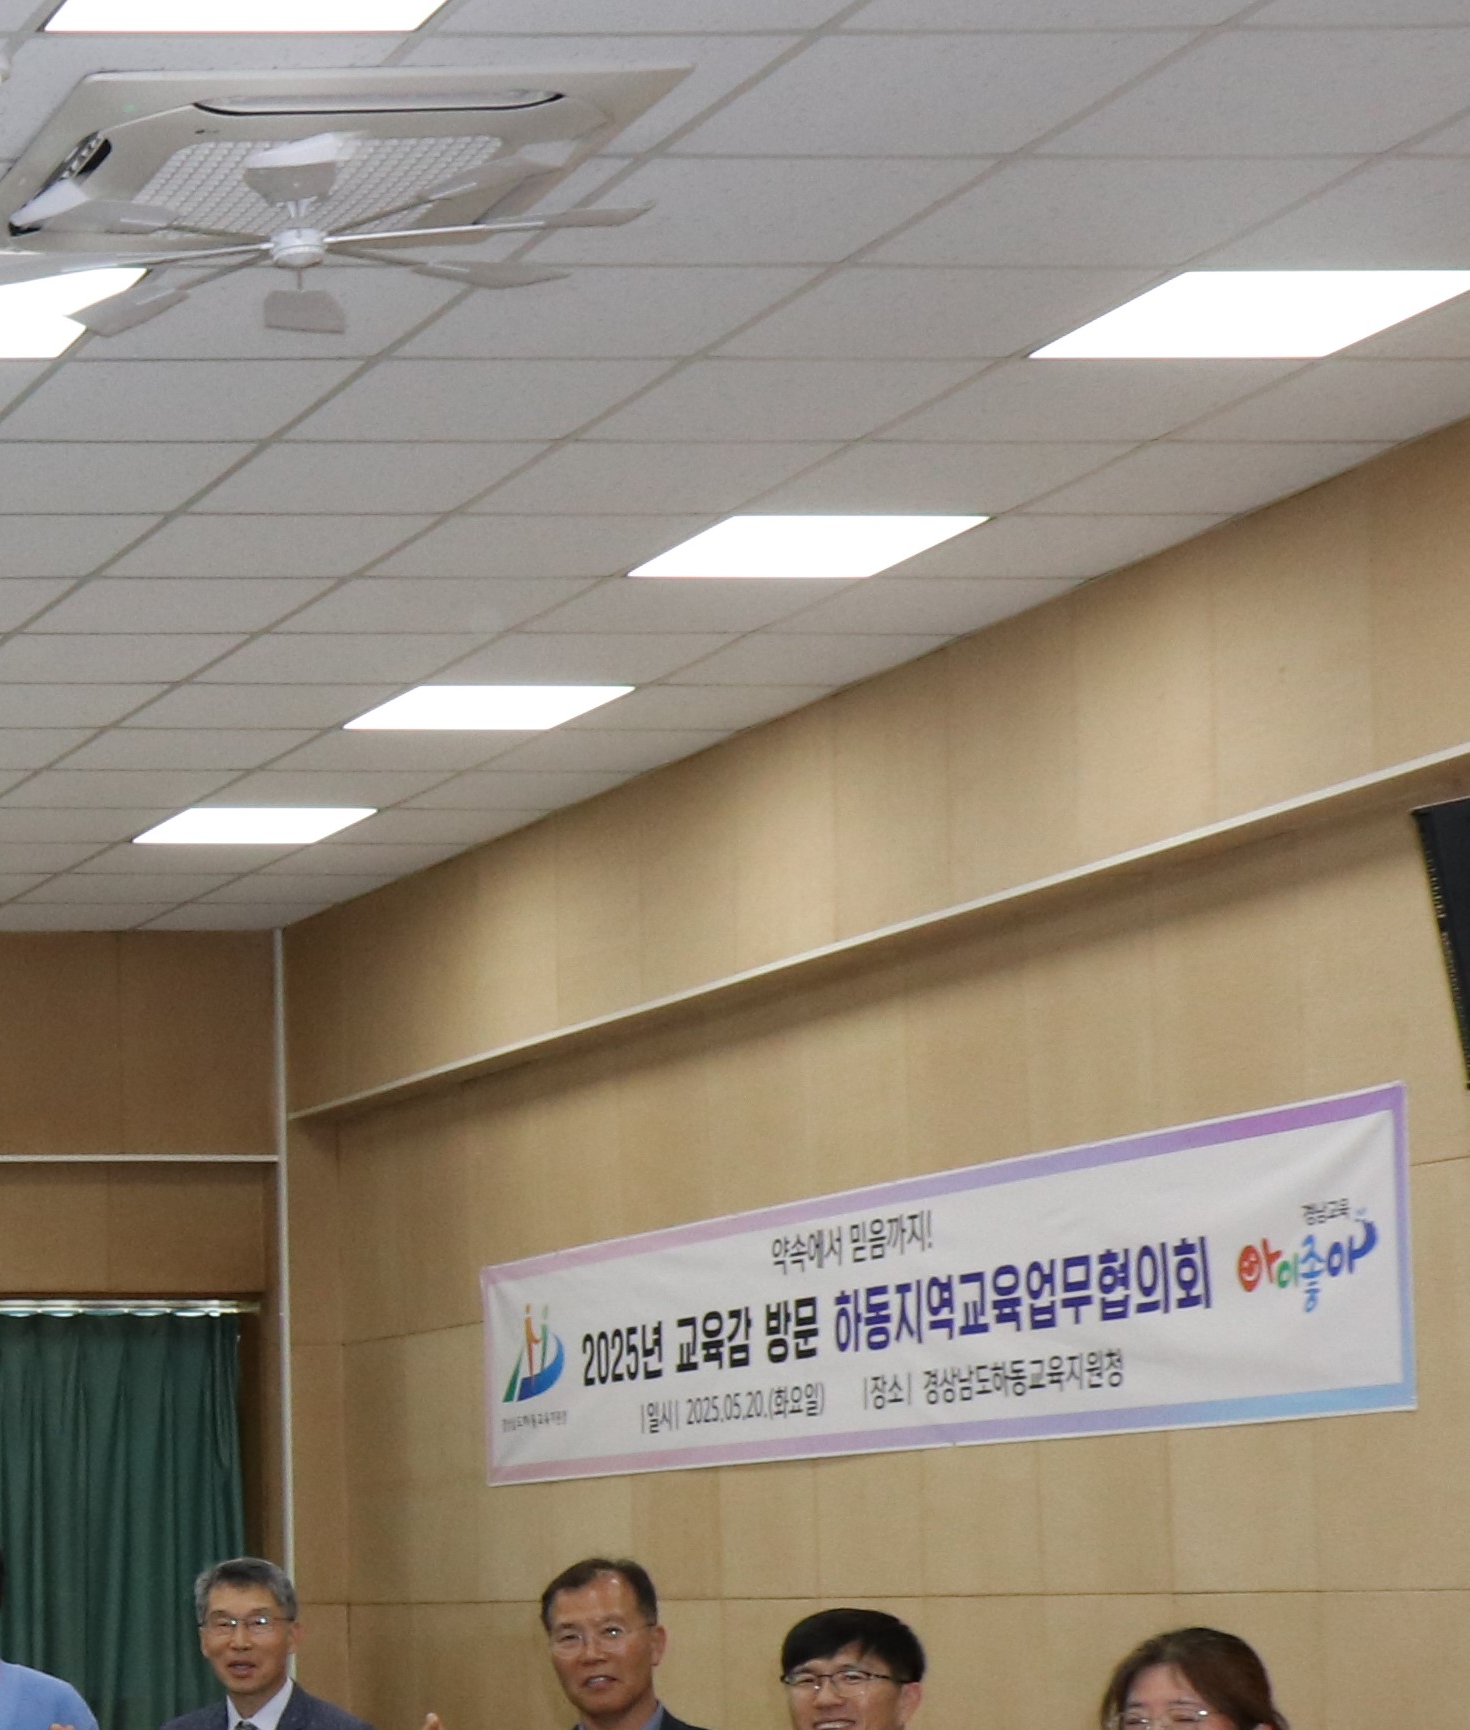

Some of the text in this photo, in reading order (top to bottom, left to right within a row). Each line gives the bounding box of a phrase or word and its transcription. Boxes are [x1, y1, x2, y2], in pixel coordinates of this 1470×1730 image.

[772, 1210, 933, 1276] 약속에서 믿음까지!
[582, 1235, 1213, 1386] 2025년 교육감 방문 하동지역교육업무협의회
[923, 1348, 1125, 1405] 경상남도하동교육지원청
